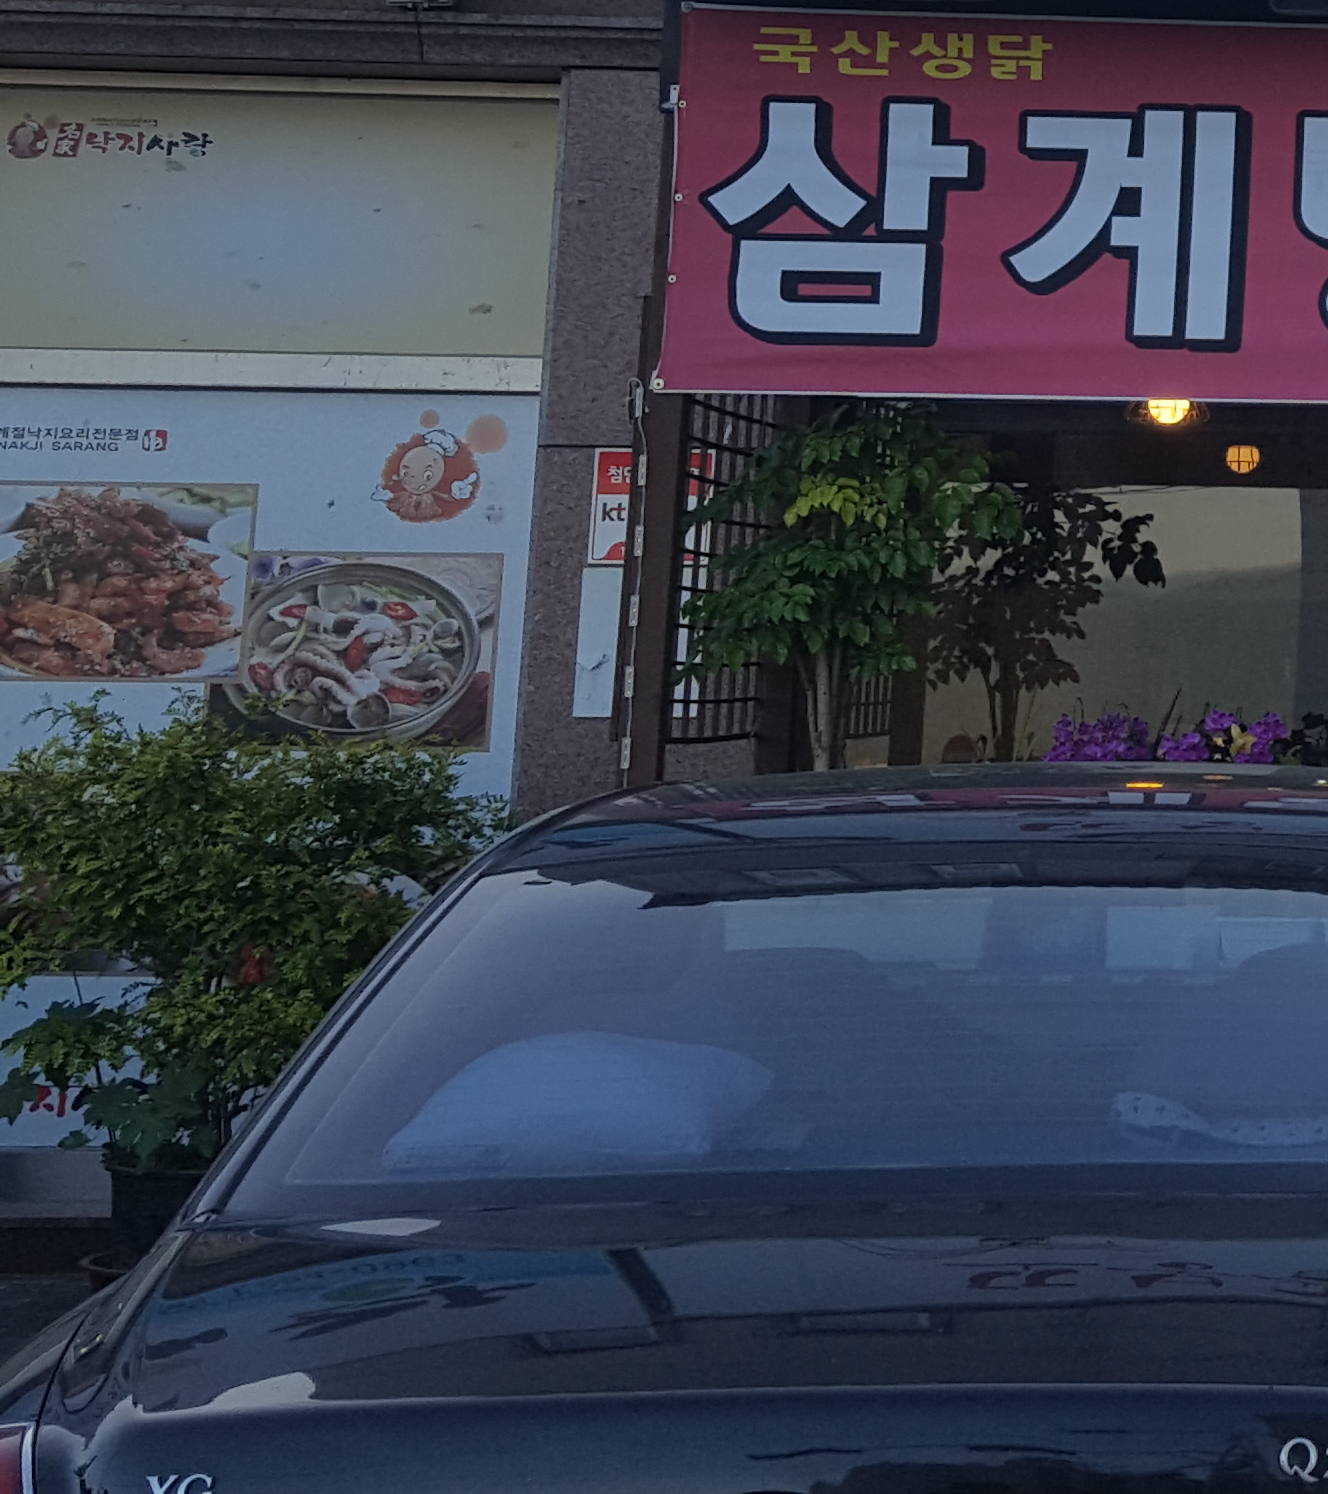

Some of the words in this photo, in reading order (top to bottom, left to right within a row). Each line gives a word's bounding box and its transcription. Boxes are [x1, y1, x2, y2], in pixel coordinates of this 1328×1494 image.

[752, 26, 1053, 82] 국산생닭
[85, 129, 214, 157] 낙지사랑
[51, 440, 119, 453] SARANG
[601, 502, 626, 522] kt
